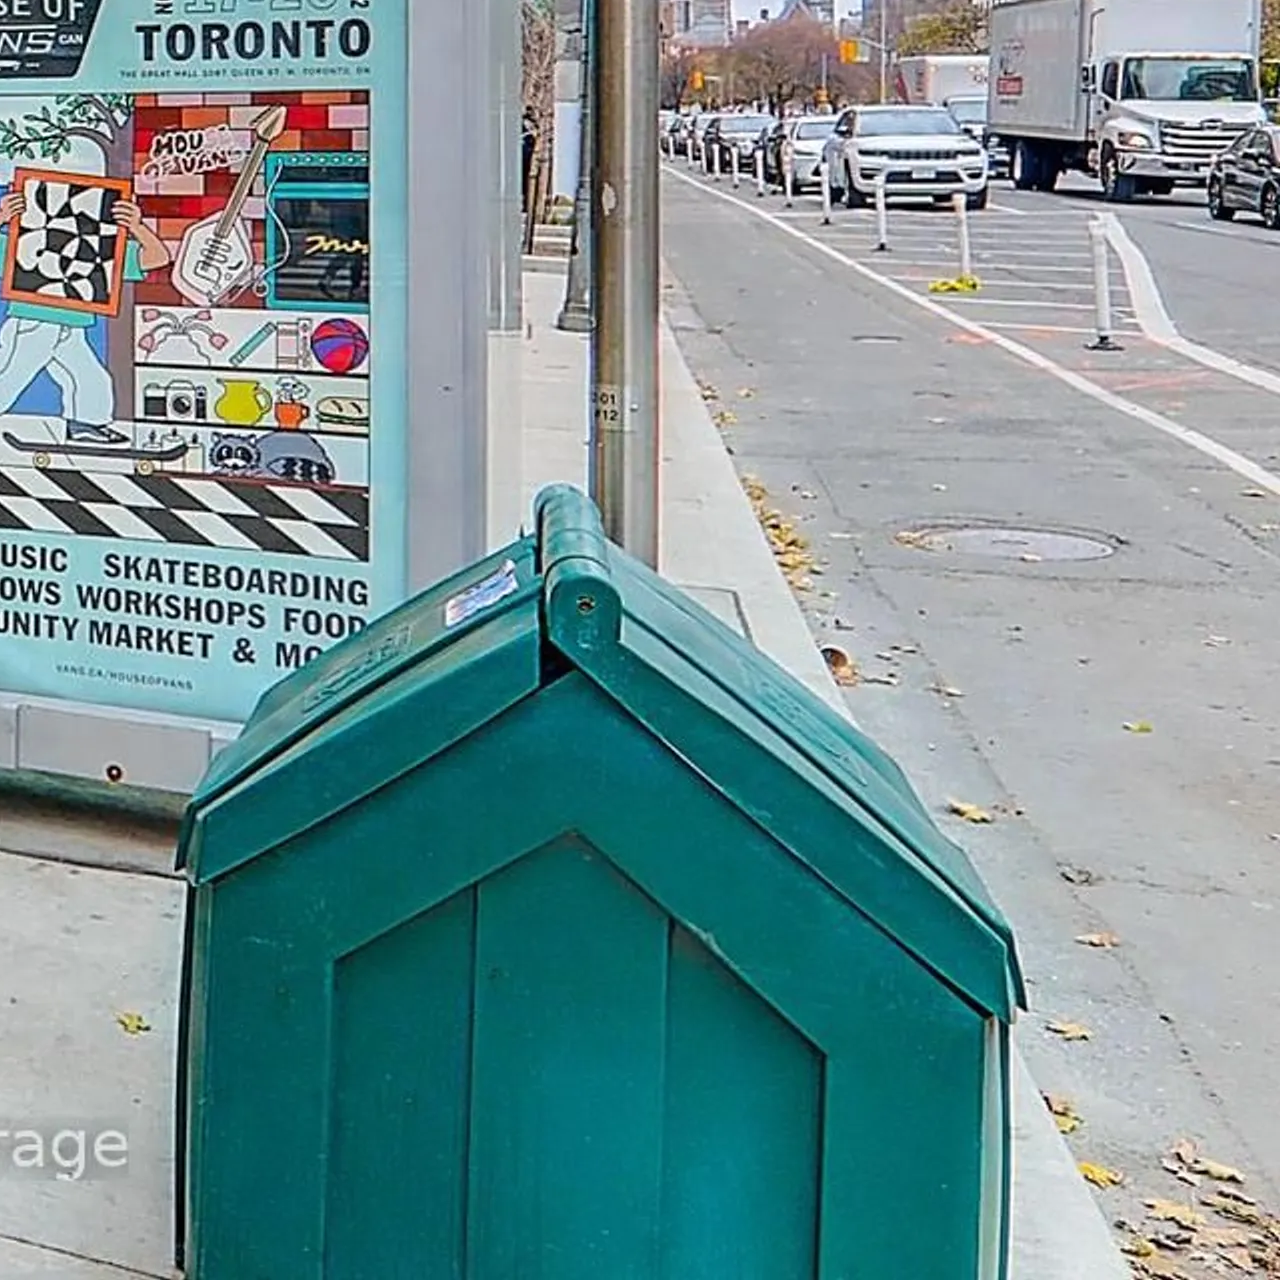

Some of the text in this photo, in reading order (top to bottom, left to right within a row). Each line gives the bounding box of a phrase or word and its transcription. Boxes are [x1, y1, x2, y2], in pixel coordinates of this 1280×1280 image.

[57, 33, 84, 46] CAN
[134, 19, 372, 62] TORONTO
[103, 553, 369, 606] SKATEBOARDING
[76, 584, 266, 629] WORKSHOPS
[283, 607, 367, 639] FOOD
[89, 620, 215, 659] MARKET
[232, 638, 256, 664] &
